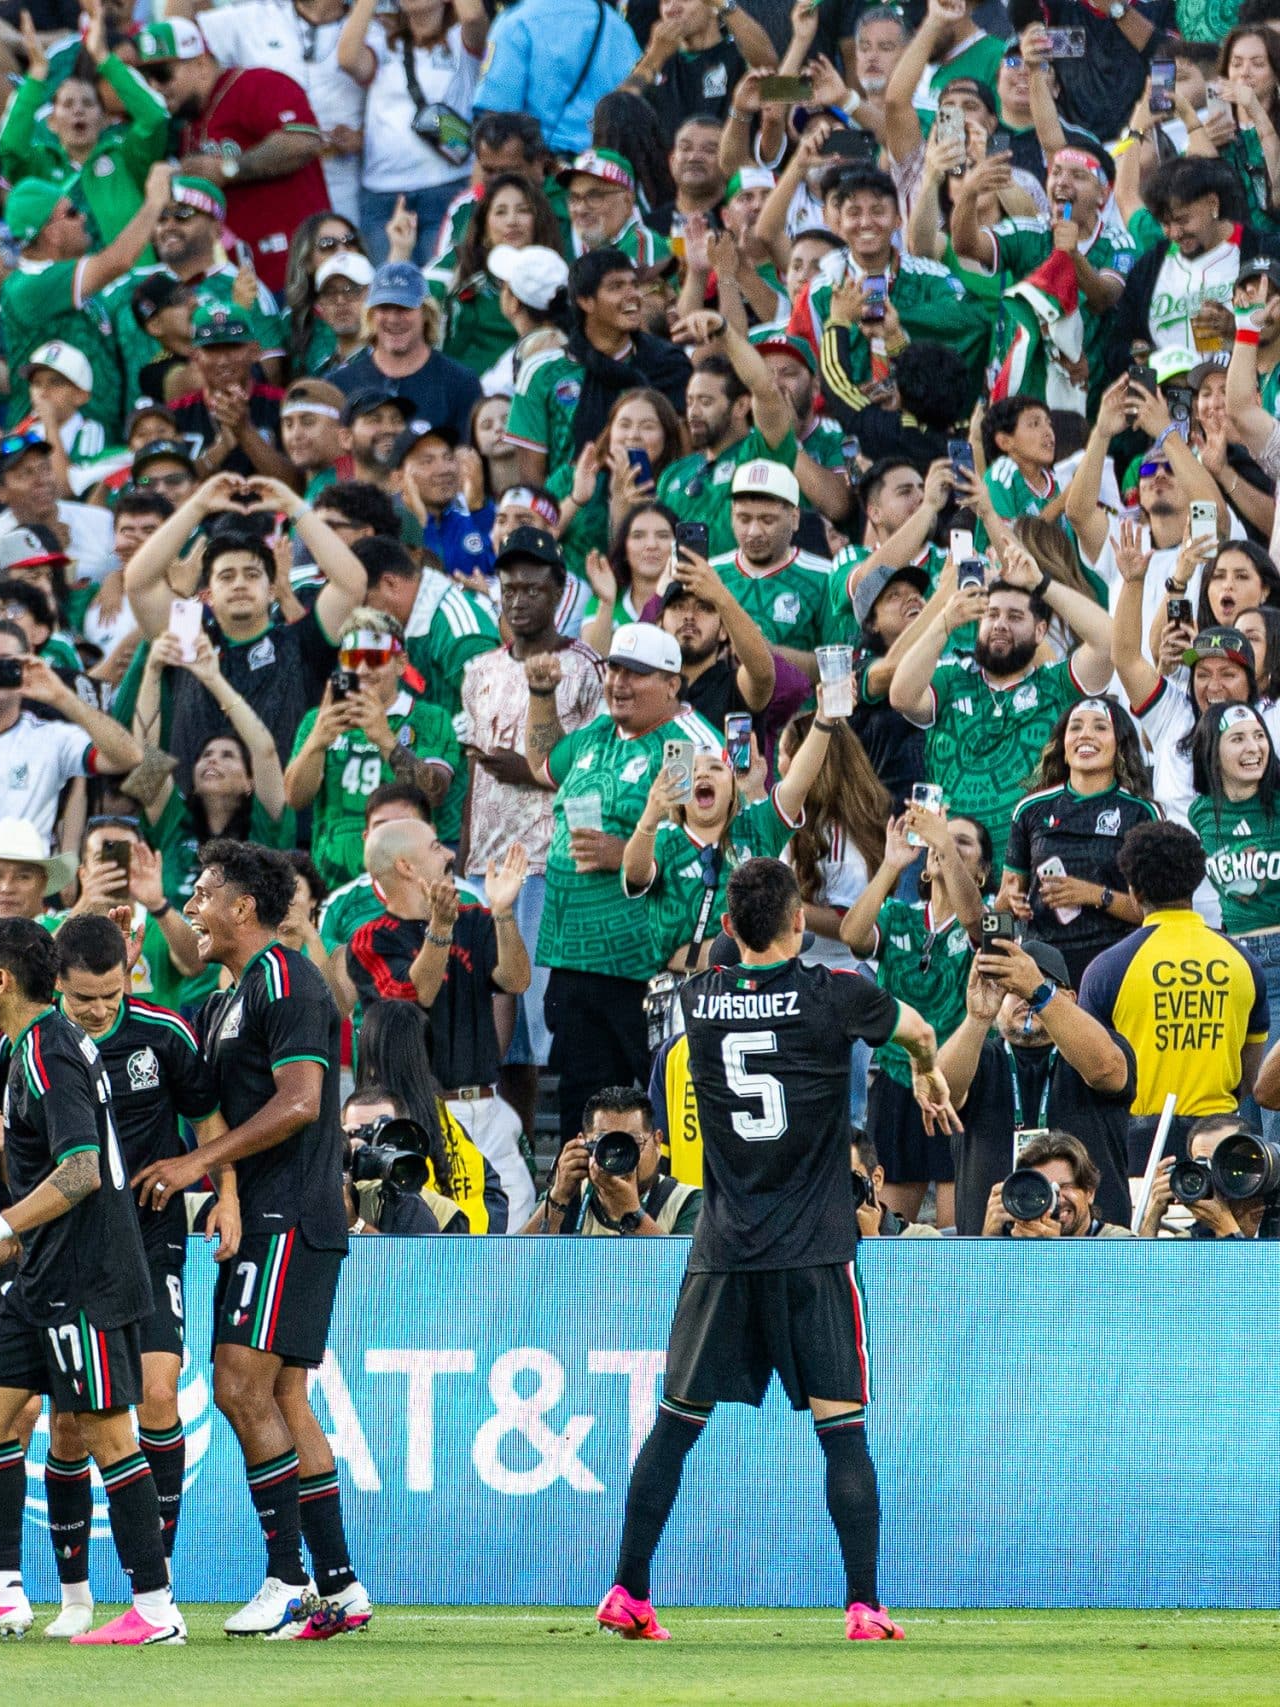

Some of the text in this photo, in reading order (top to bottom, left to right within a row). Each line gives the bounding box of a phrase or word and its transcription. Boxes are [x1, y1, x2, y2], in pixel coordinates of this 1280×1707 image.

[1150, 281, 1234, 317] Dodger
[341, 757, 381, 796] 49
[1152, 960, 1230, 987] CSC
[692, 991, 800, 1019] J.VÁSQUEZ
[1154, 990, 1229, 1020] EVENT
[1155, 1023, 1224, 1052] STAFF
[722, 1031, 788, 1142] 5
[237, 1262, 258, 1307] 7
[48, 1324, 83, 1372] 17
[307, 1347, 666, 1495] AT&T
